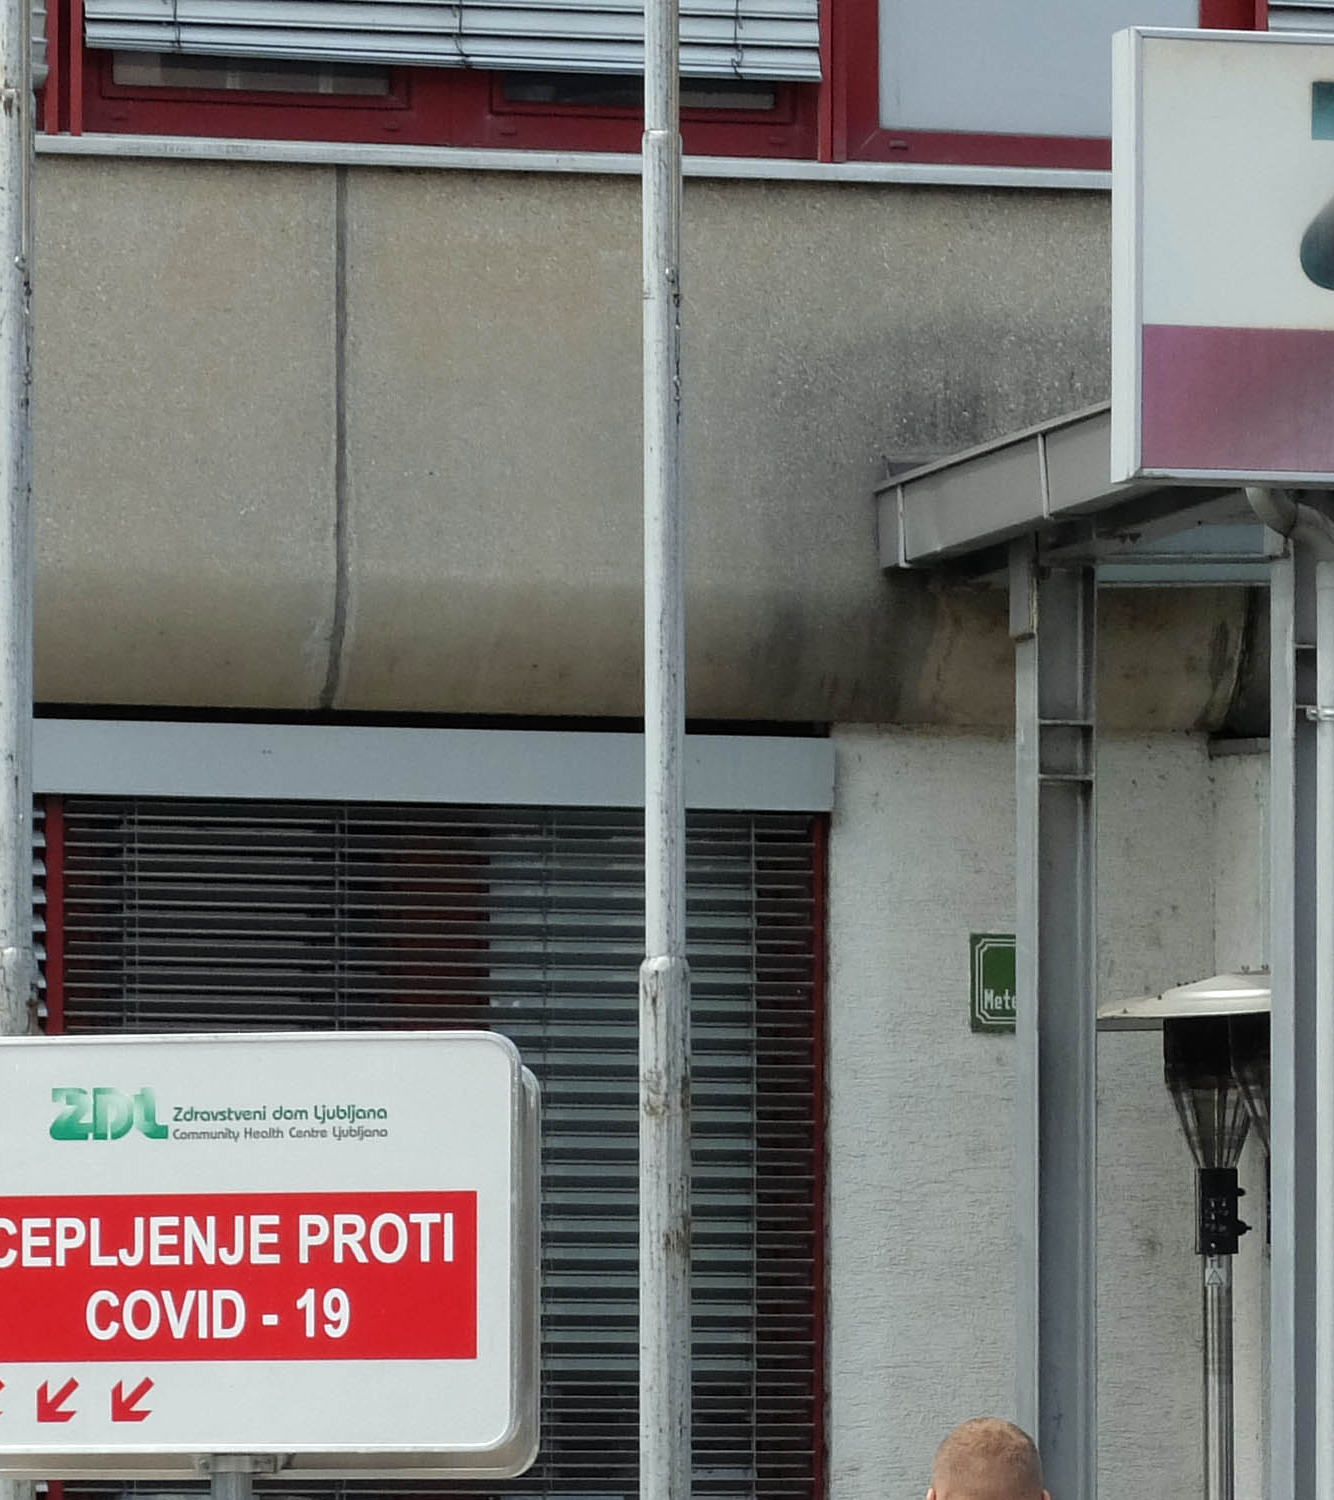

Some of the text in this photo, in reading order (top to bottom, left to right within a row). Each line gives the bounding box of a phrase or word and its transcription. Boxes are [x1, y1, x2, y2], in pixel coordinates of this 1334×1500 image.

[173, 1104, 388, 1124] Zdravstveni dom Ljubljana
[173, 1124, 388, 1143] Community Health Centre Ljubljana
[298, 1212, 454, 1263] PROTI
[85, 1287, 351, 1341] COVID - 19
